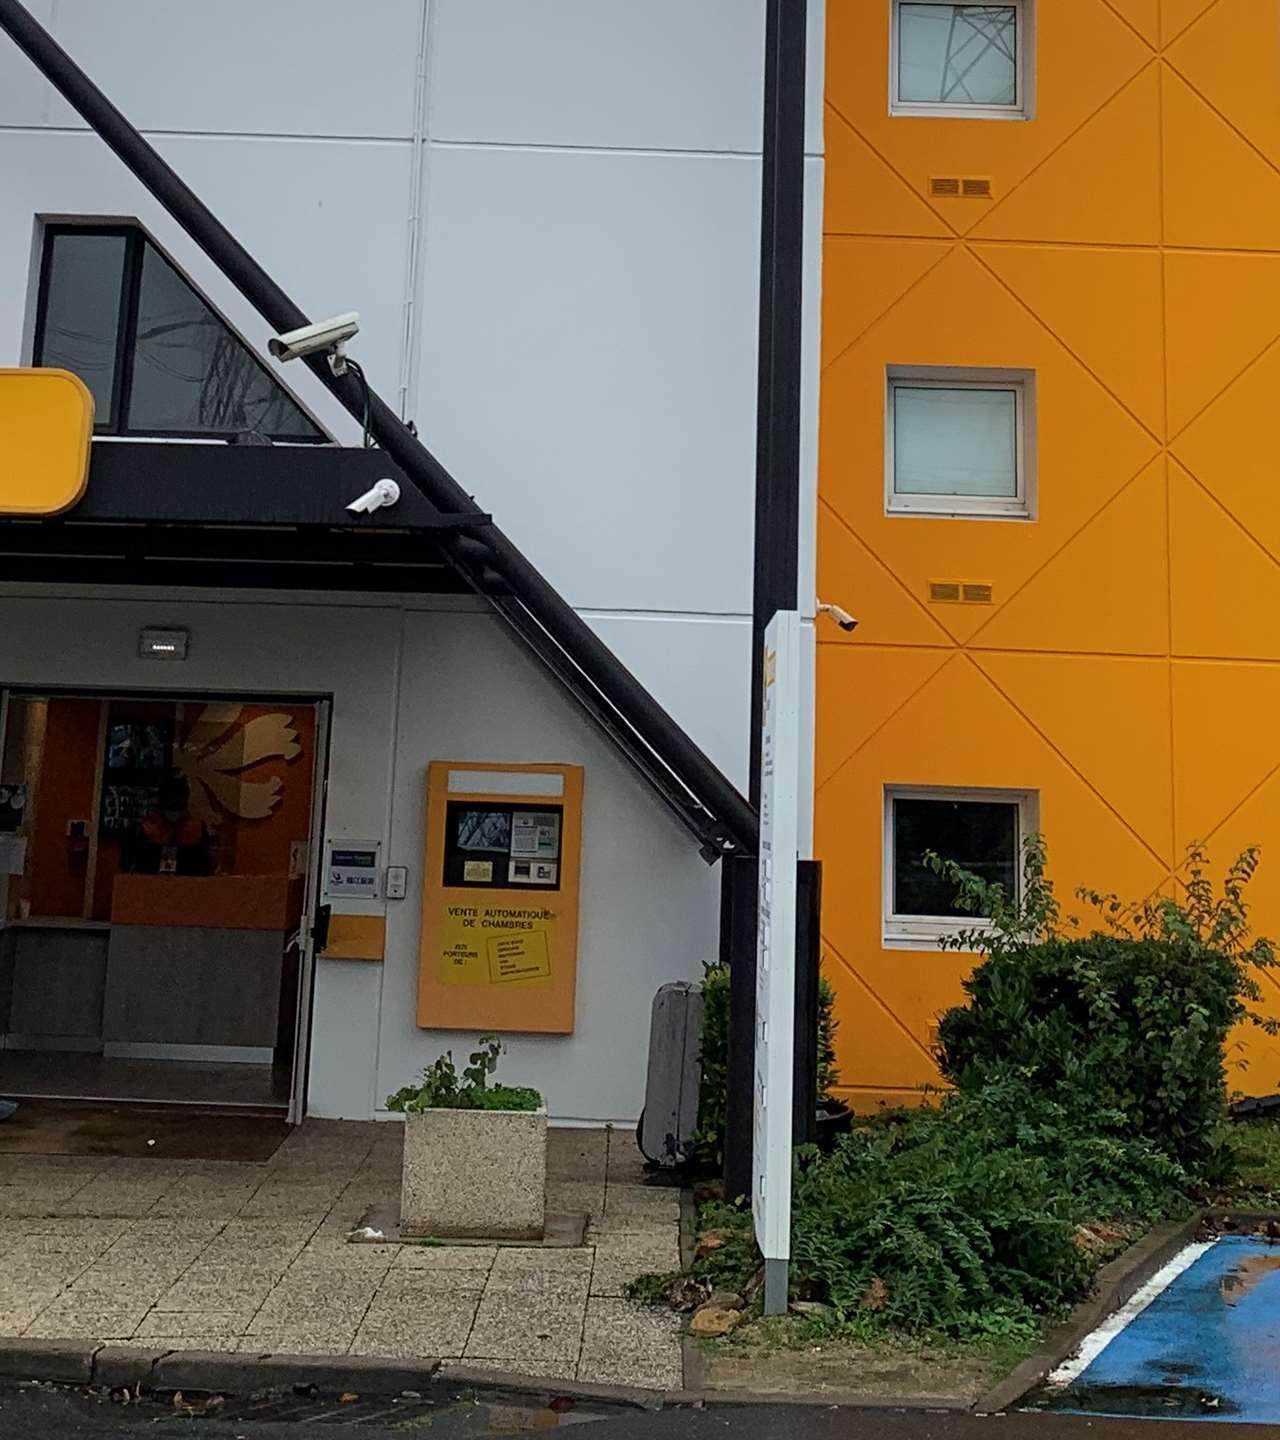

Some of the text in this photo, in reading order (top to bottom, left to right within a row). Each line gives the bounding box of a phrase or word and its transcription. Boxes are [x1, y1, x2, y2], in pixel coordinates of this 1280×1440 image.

[448, 907, 550, 920] VENTE AUTOMATIQUE
[463, 920, 533, 929] DE CHAMBRES
